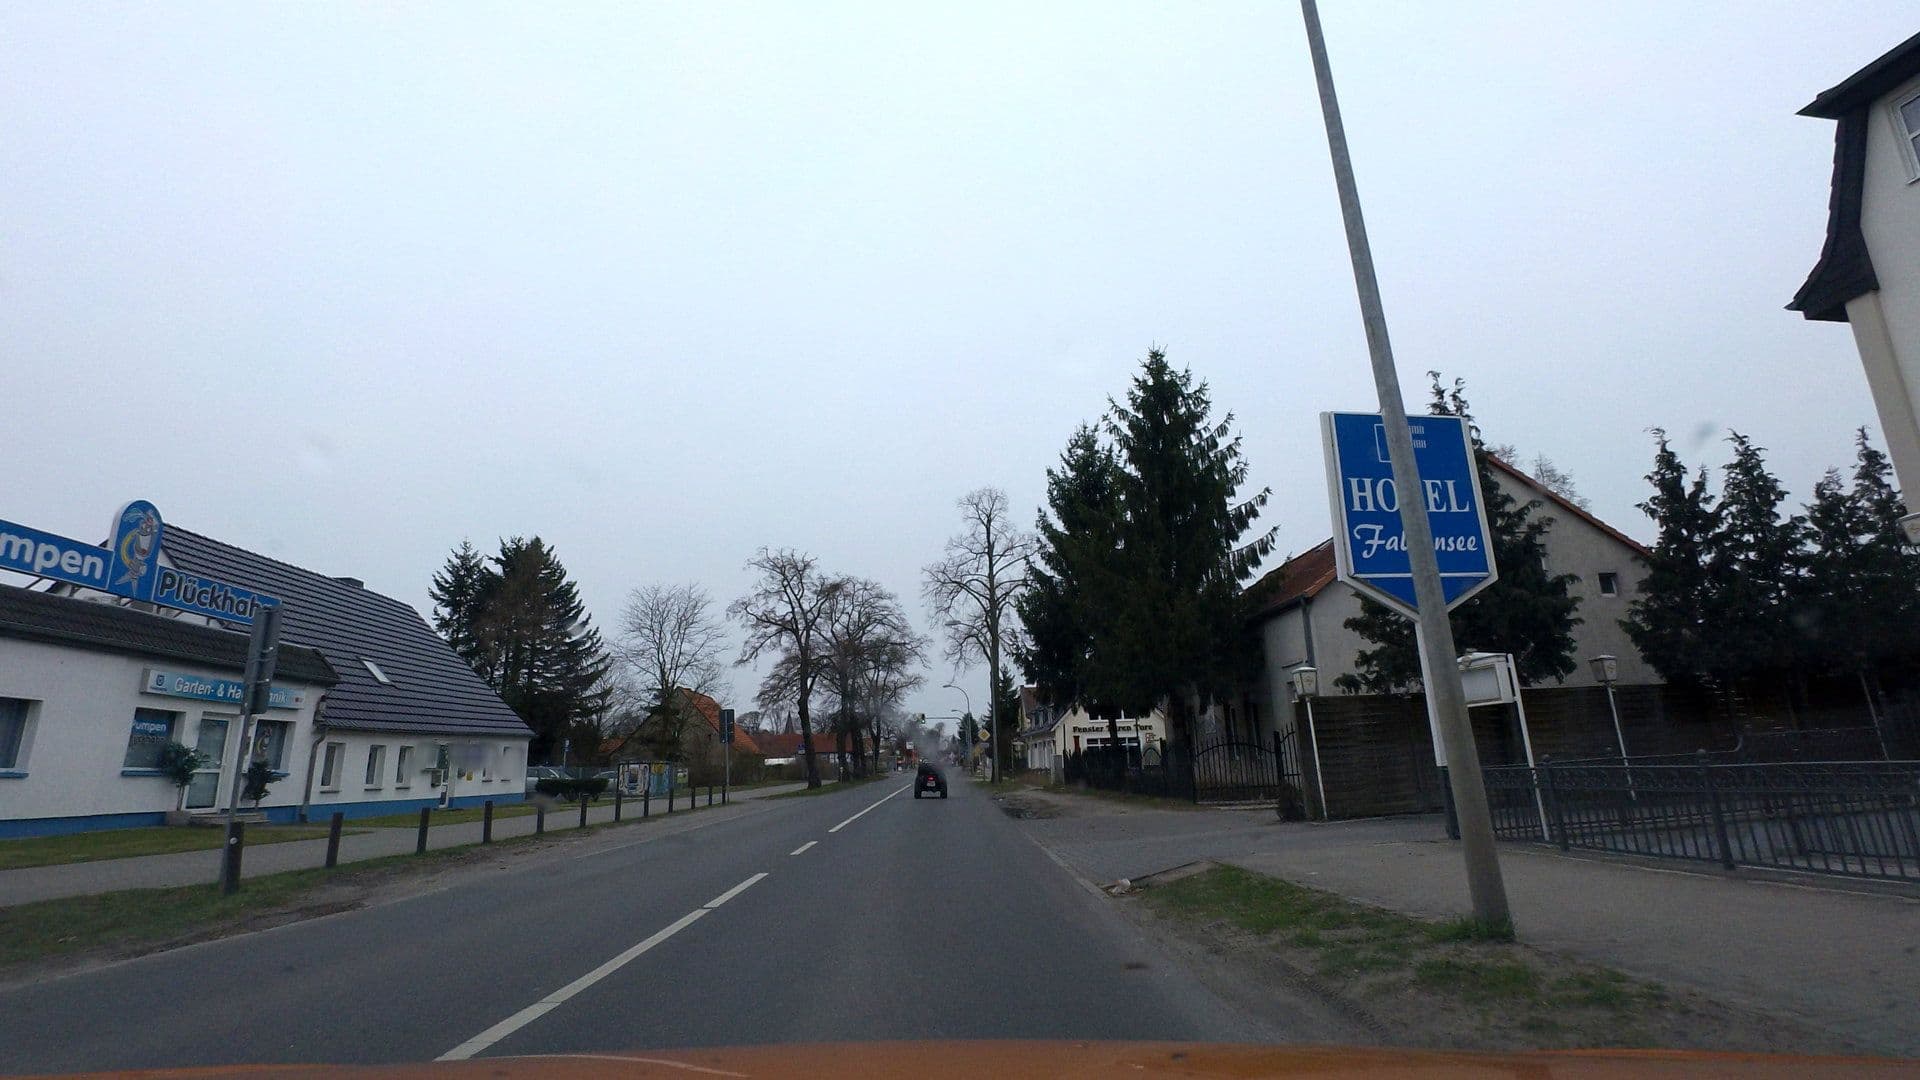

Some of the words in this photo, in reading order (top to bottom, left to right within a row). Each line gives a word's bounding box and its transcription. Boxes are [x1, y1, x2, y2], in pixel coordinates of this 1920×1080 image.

[1348, 477, 1469, 512] HOEL
[1354, 523, 1478, 559] Falnsee
[158, 569, 273, 619] Plückhah
[175, 676, 214, 696] Garten-
[217, 683, 225, 697] &
[1073, 725, 1104, 733] Fenster
[1107, 724, 1131, 732] Tren
